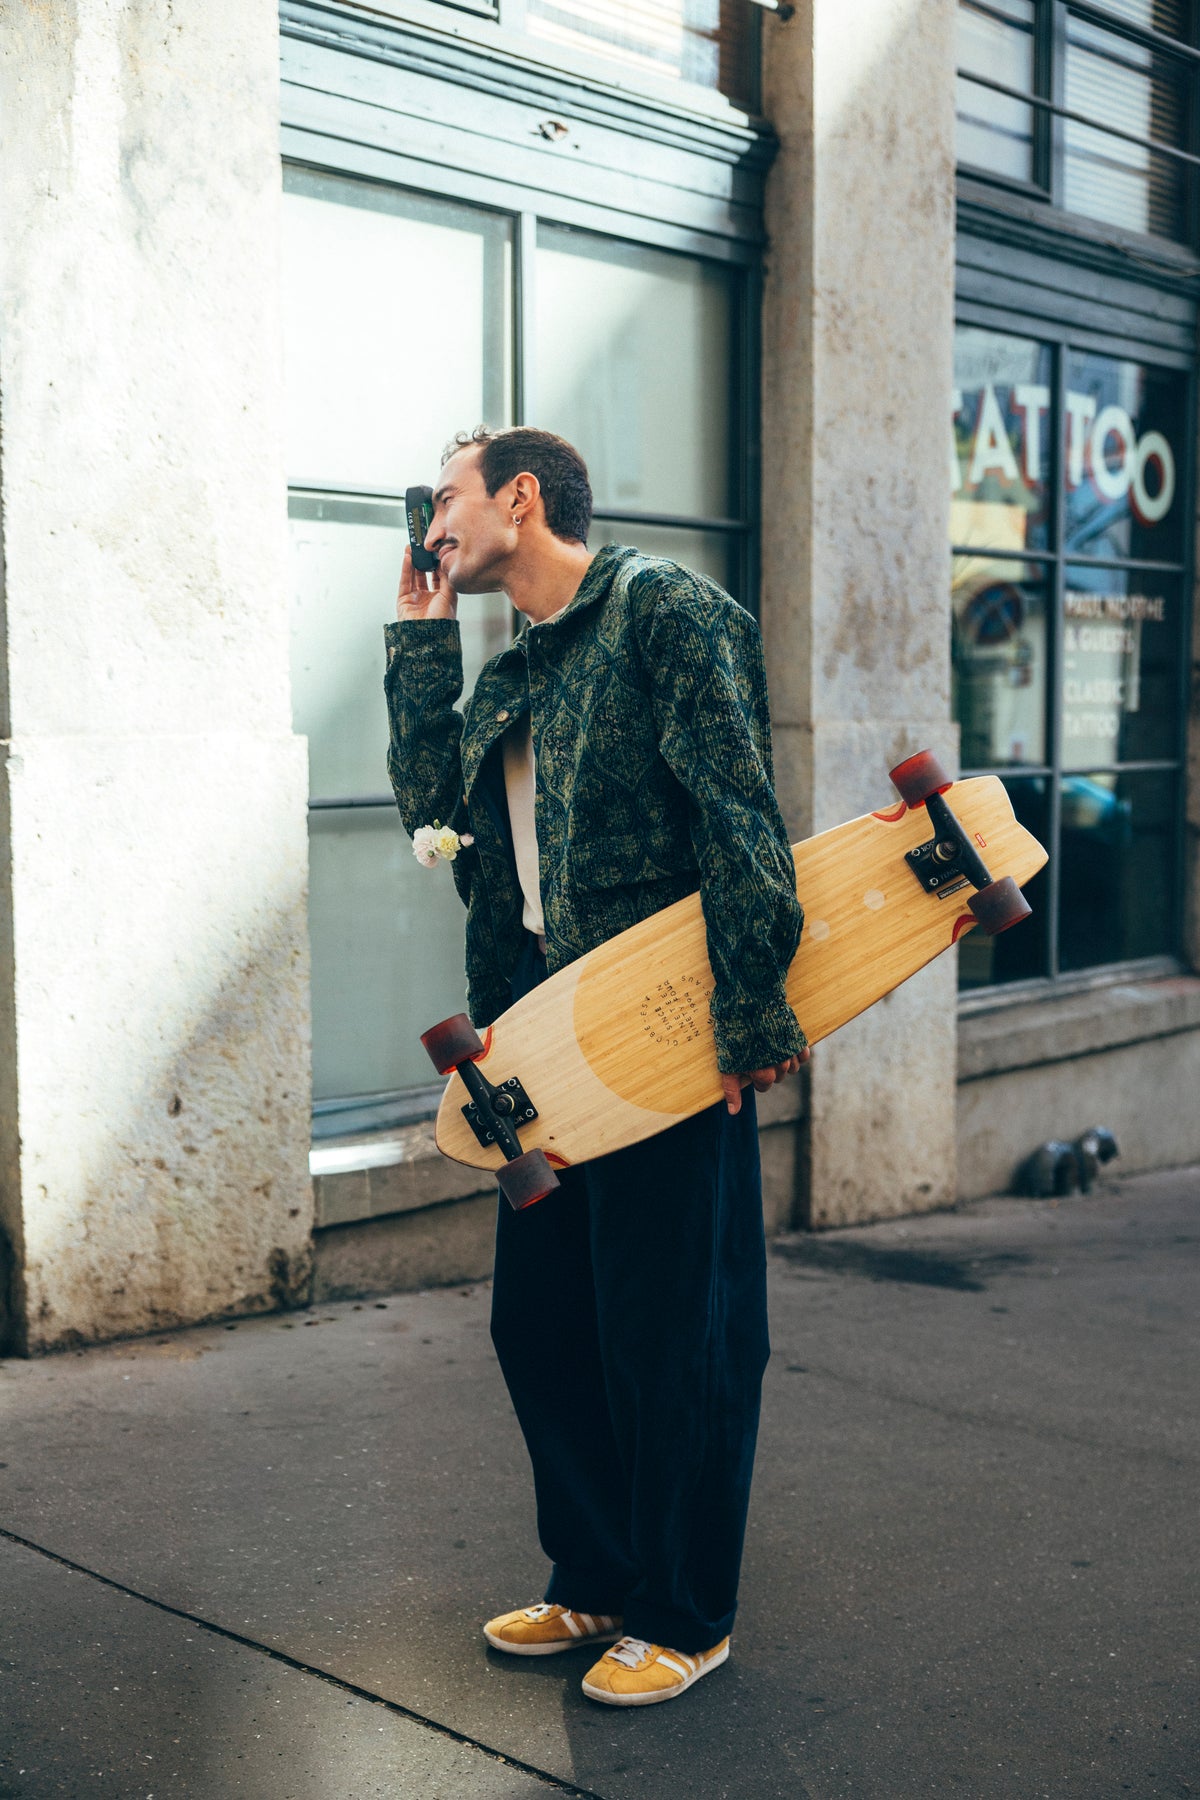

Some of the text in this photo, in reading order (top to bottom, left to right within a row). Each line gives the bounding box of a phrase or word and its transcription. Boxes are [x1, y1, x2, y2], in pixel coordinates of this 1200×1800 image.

[655, 1006, 673, 1031] SINCE
[656, 985, 693, 1042] NINETEEN
[664, 980, 700, 1038] NINETY FOUR
[684, 992, 699, 1013] 1994
